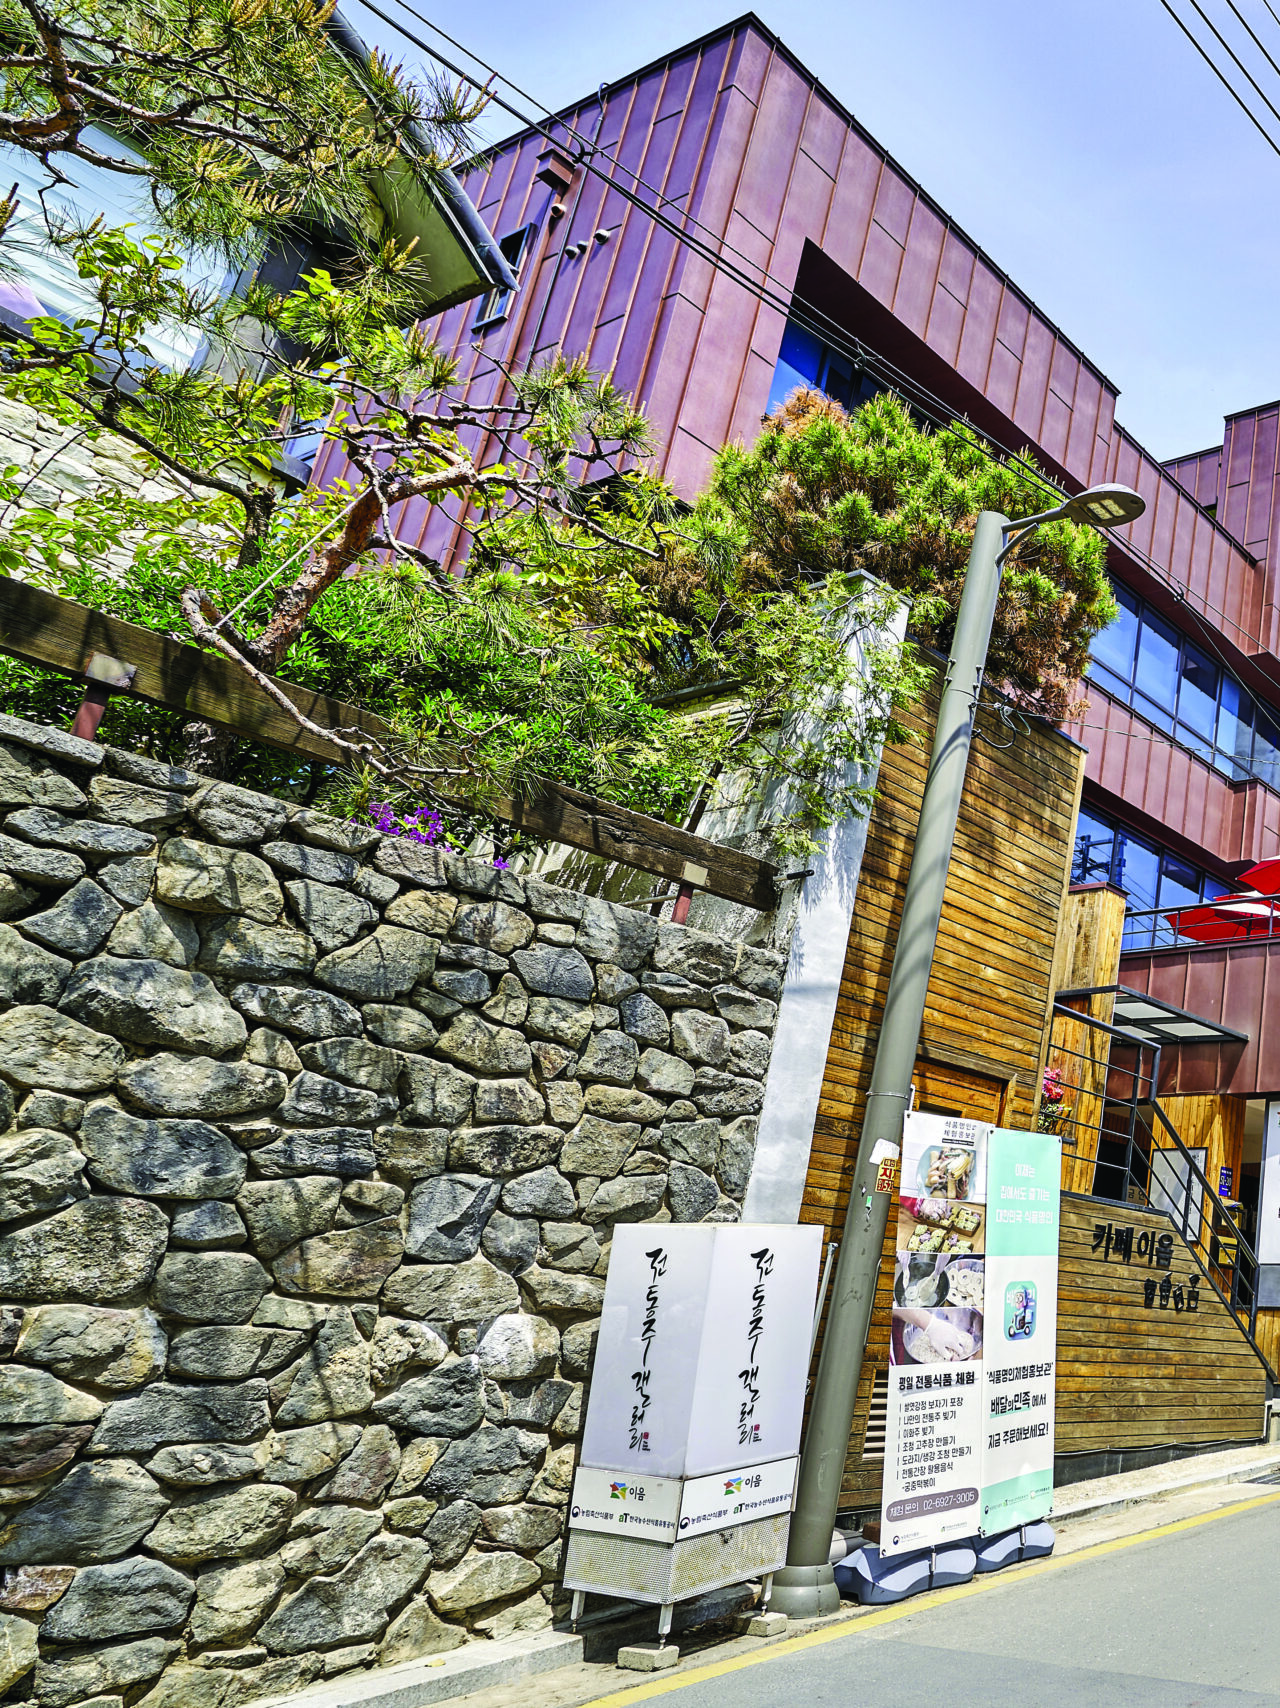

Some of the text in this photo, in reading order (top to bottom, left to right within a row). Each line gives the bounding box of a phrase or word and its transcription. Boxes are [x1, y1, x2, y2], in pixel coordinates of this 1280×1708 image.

[640, 1248, 668, 1367] 전통주
[748, 1248, 774, 1364] 전통주
[899, 1371, 975, 1391] 평일 전통식품 체험
[628, 1370, 651, 1453] 갤러리
[737, 1366, 760, 1446] 갤러리
[990, 1391, 1046, 1415] 배달의민족 에서
[904, 1415, 921, 1425] 나만의
[922, 1412, 941, 1423] 전통주
[916, 1438, 934, 1449] 고추장
[936, 1436, 956, 1447] 만들기
[988, 1422, 1049, 1450] 지금 주문해보세요!
[744, 1474, 763, 1488] 이음
[629, 1486, 646, 1501] 이음
[905, 1502, 918, 1514] 문의
[923, 1491, 975, 1511] 02-6927-3005
